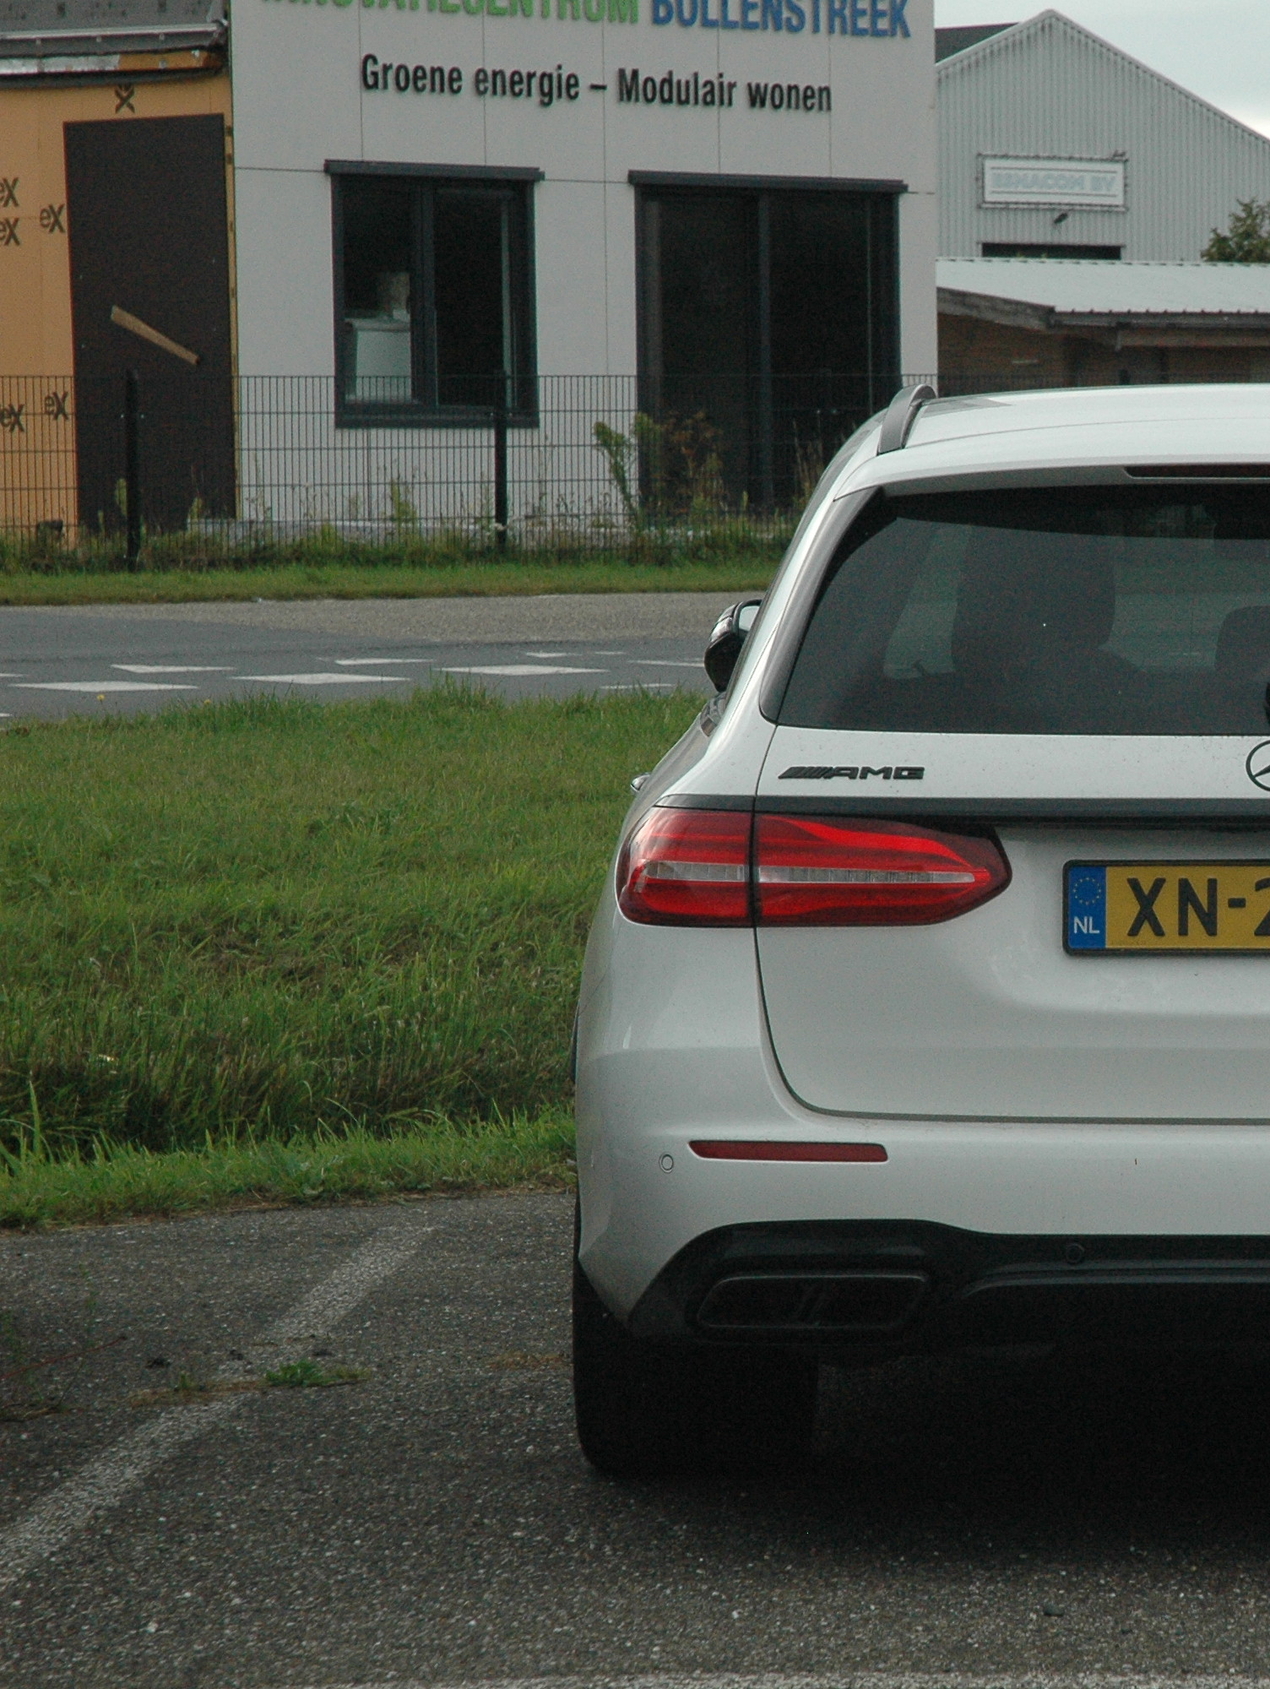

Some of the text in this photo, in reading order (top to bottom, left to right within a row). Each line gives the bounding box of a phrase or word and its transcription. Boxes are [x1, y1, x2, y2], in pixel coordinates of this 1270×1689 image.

[361, 53, 463, 94] Groene
[474, 64, 580, 107] energie
[618, 67, 738, 108] Modulair
[747, 81, 832, 112] wonen
[820, 766, 925, 780] AMG
[1073, 916, 1100, 935] NL
